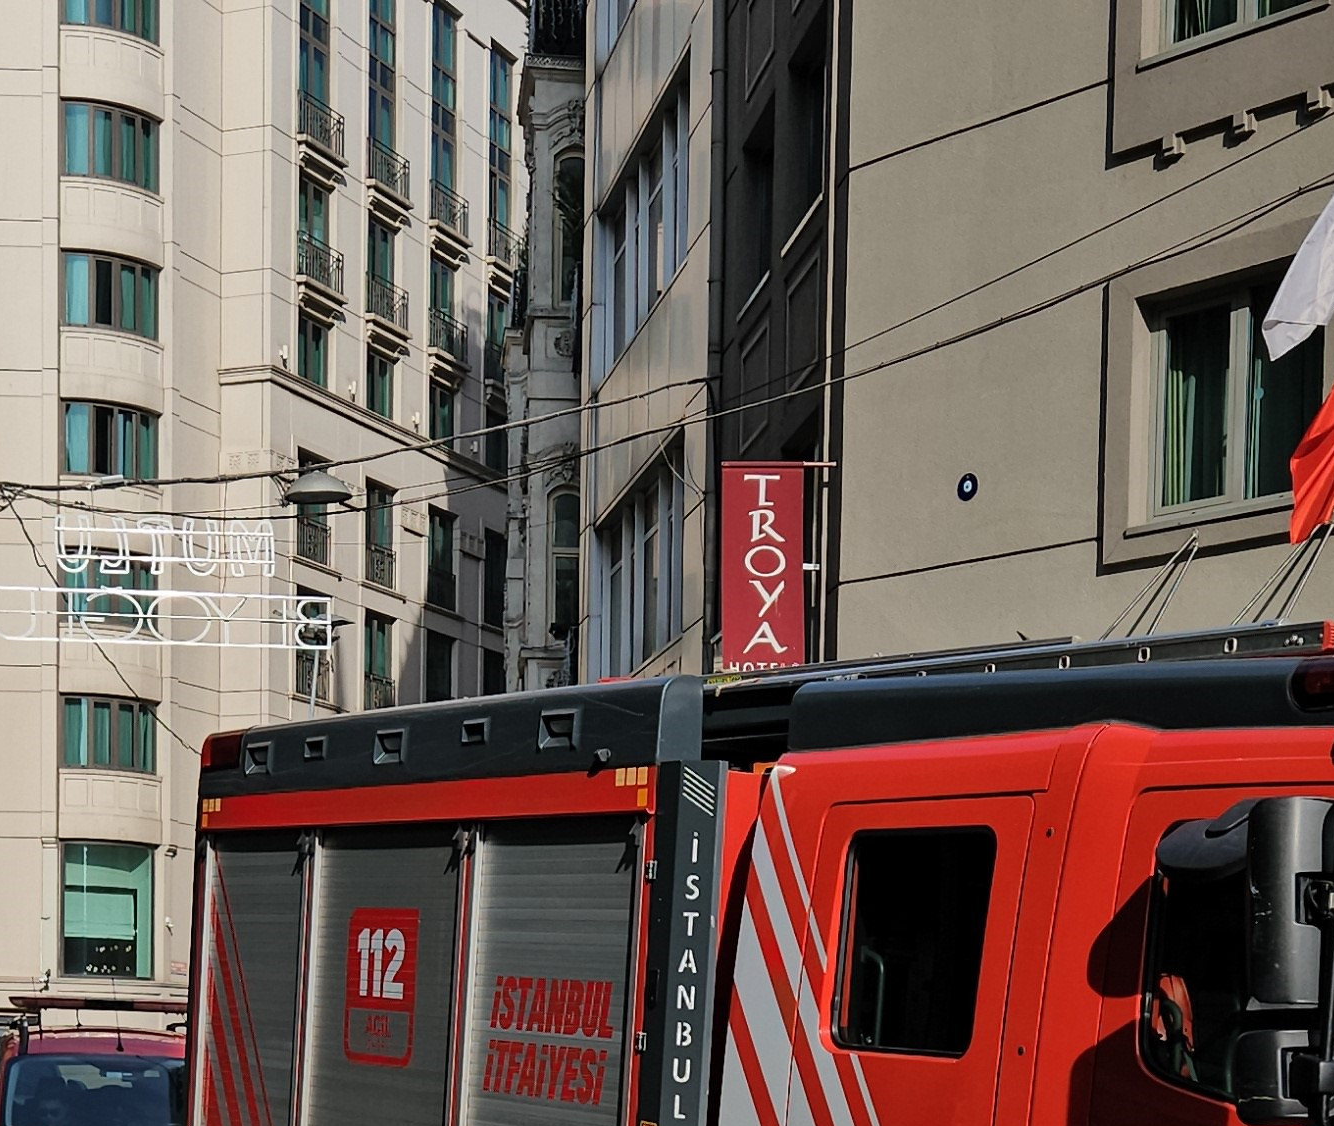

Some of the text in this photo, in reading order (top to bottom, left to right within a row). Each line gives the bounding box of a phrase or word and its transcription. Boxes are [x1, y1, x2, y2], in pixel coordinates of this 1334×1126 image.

[743, 474, 788, 654] TROYA
[358, 927, 405, 1000] 112
[672, 831, 701, 1120] İSTANBUL
[490, 976, 613, 1038] İSTANBUL
[483, 1040, 607, 1105] İTFAİYESİ
